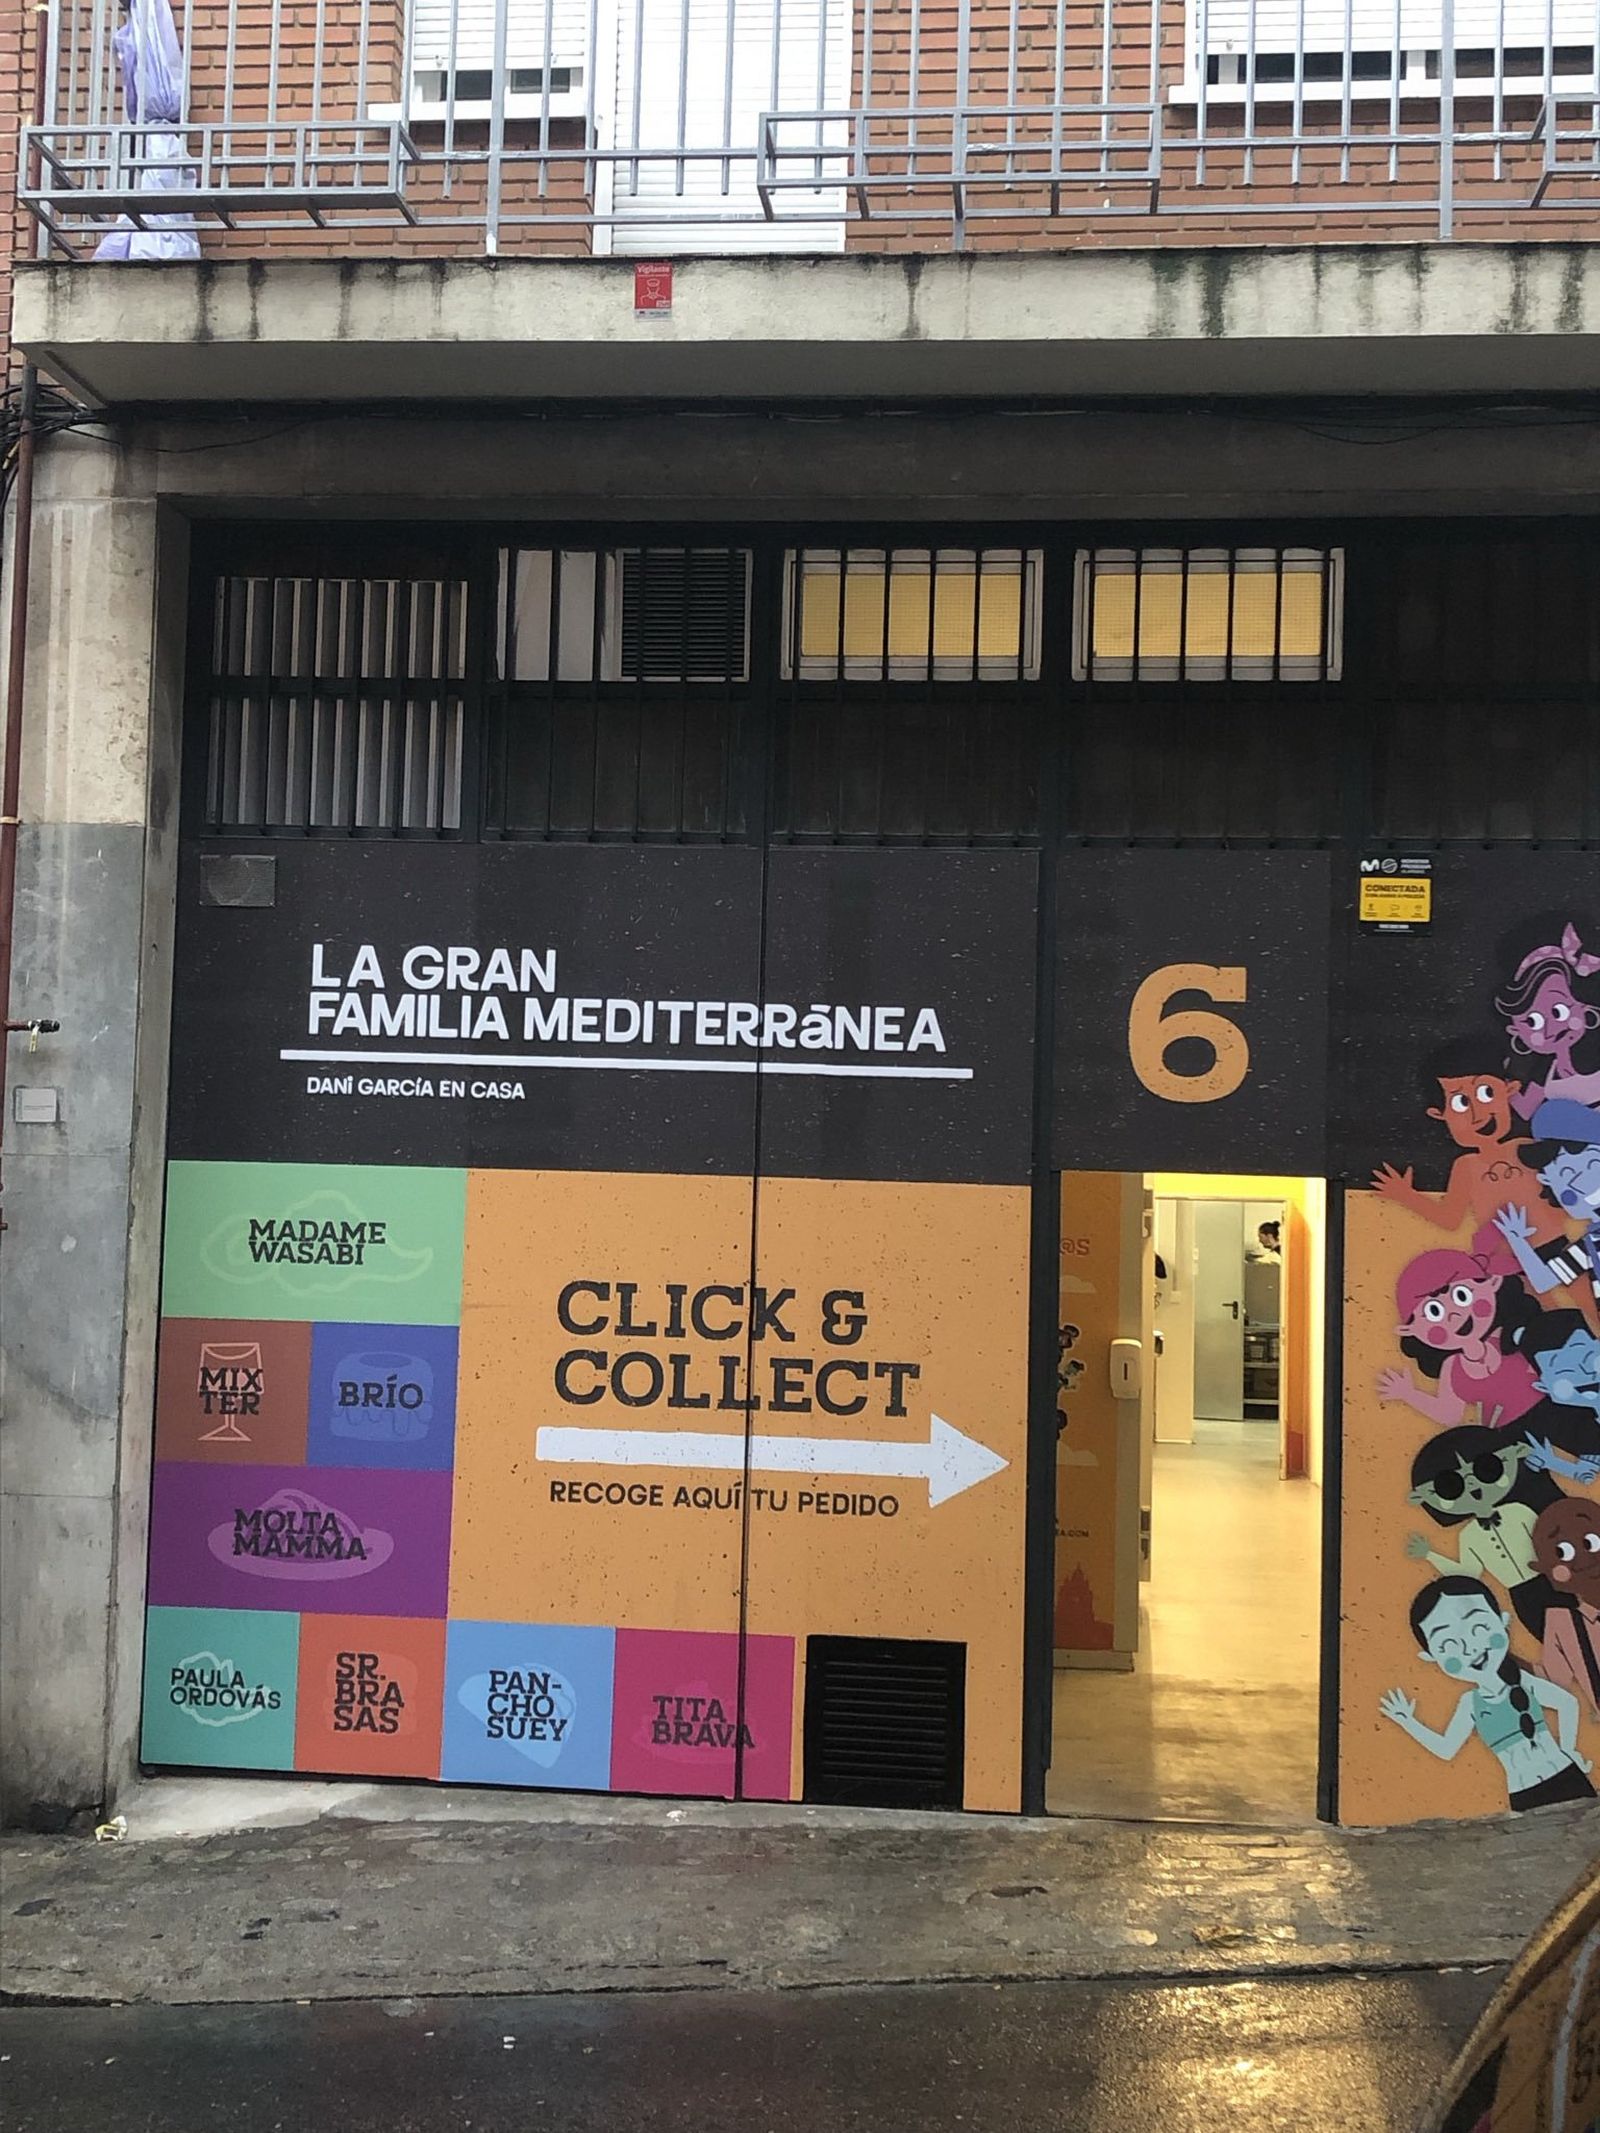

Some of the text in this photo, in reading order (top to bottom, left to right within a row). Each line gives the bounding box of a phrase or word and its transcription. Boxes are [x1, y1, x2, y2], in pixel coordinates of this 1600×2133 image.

[1365, 884, 1426, 893] CONECTADA
[311, 943, 557, 993] LA GRAN
[308, 991, 510, 1040] FAMILIA
[1128, 962, 1250, 1103] 6
[439, 1080, 466, 1098] EN
[470, 1081, 526, 1100] CASA
[248, 1218, 387, 1245] MADAME
[248, 1241, 366, 1266] WASABI
[556, 1279, 868, 1346] CLICK &
[199, 1366, 264, 1392] MIX
[337, 1374, 424, 1410] BRÍO
[553, 1349, 921, 1418] COLLECT
[200, 1391, 261, 1416] TER
[549, 1480, 900, 1518] RECOGE AQUÍ TU PEDIDO
[233, 1508, 342, 1536] MOLTA
[232, 1532, 368, 1561] MAMMA
[170, 1667, 246, 1689] PAULA
[335, 1652, 387, 1681] SR.
[334, 1679, 405, 1708] BRA
[488, 1669, 562, 1695] PAN-
[169, 1684, 282, 1710] ORDOVÁS
[486, 1692, 555, 1718] CHO
[652, 1695, 728, 1723] TITA
[333, 1704, 400, 1734] SAS
[486, 1715, 568, 1742] SUEY
[651, 1719, 756, 1750] BRAVA
